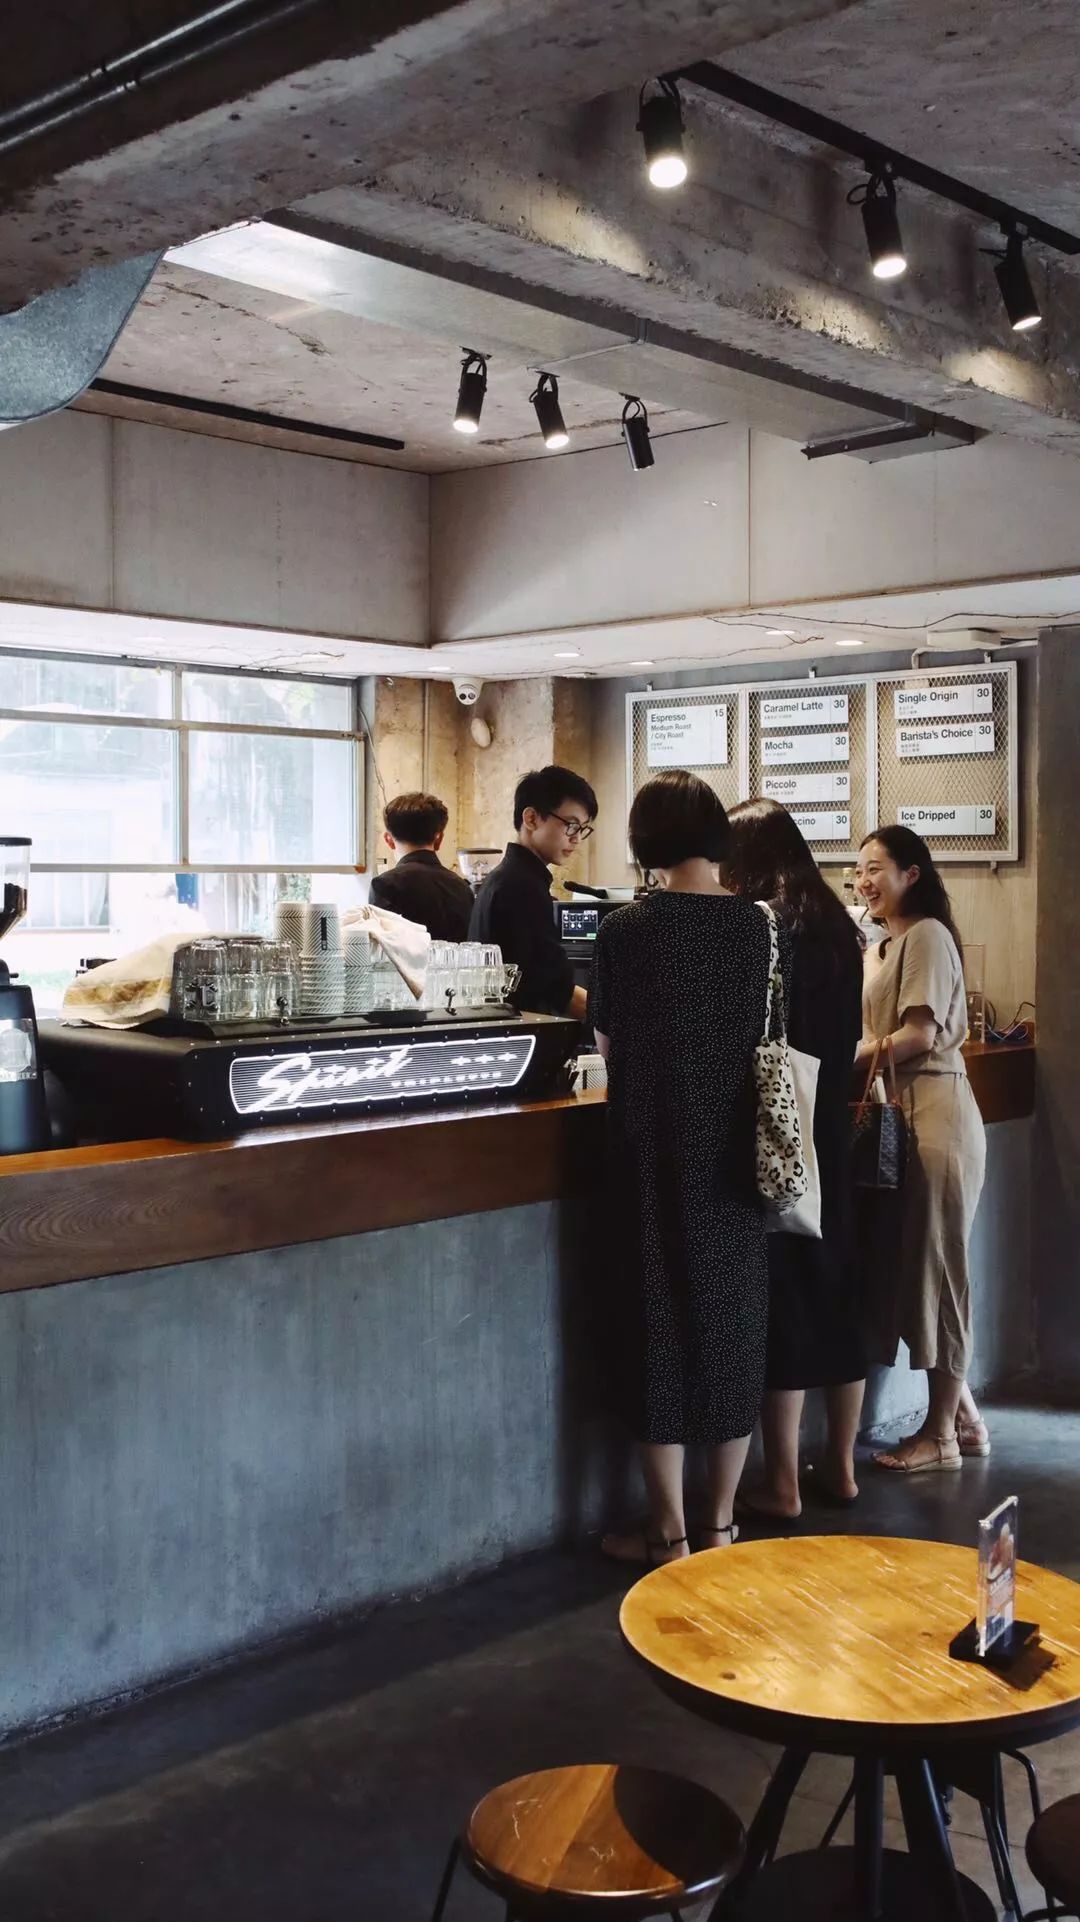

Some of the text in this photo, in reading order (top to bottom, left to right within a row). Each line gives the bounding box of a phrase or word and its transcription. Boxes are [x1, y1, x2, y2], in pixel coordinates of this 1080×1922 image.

[898, 688, 989, 704] Single Origin 30
[763, 699, 845, 713] Caramel Latte 30
[651, 709, 724, 724] Espresso 15
[654, 732, 666, 740] City
[900, 725, 991, 742] Barista's Choice 30
[765, 736, 847, 750] Mocha 30
[765, 776, 848, 789] Piccolo 30
[836, 815, 848, 824] 30
[901, 809, 992, 821] Ice Dripped 30
[246, 1048, 413, 1112] Spirit
